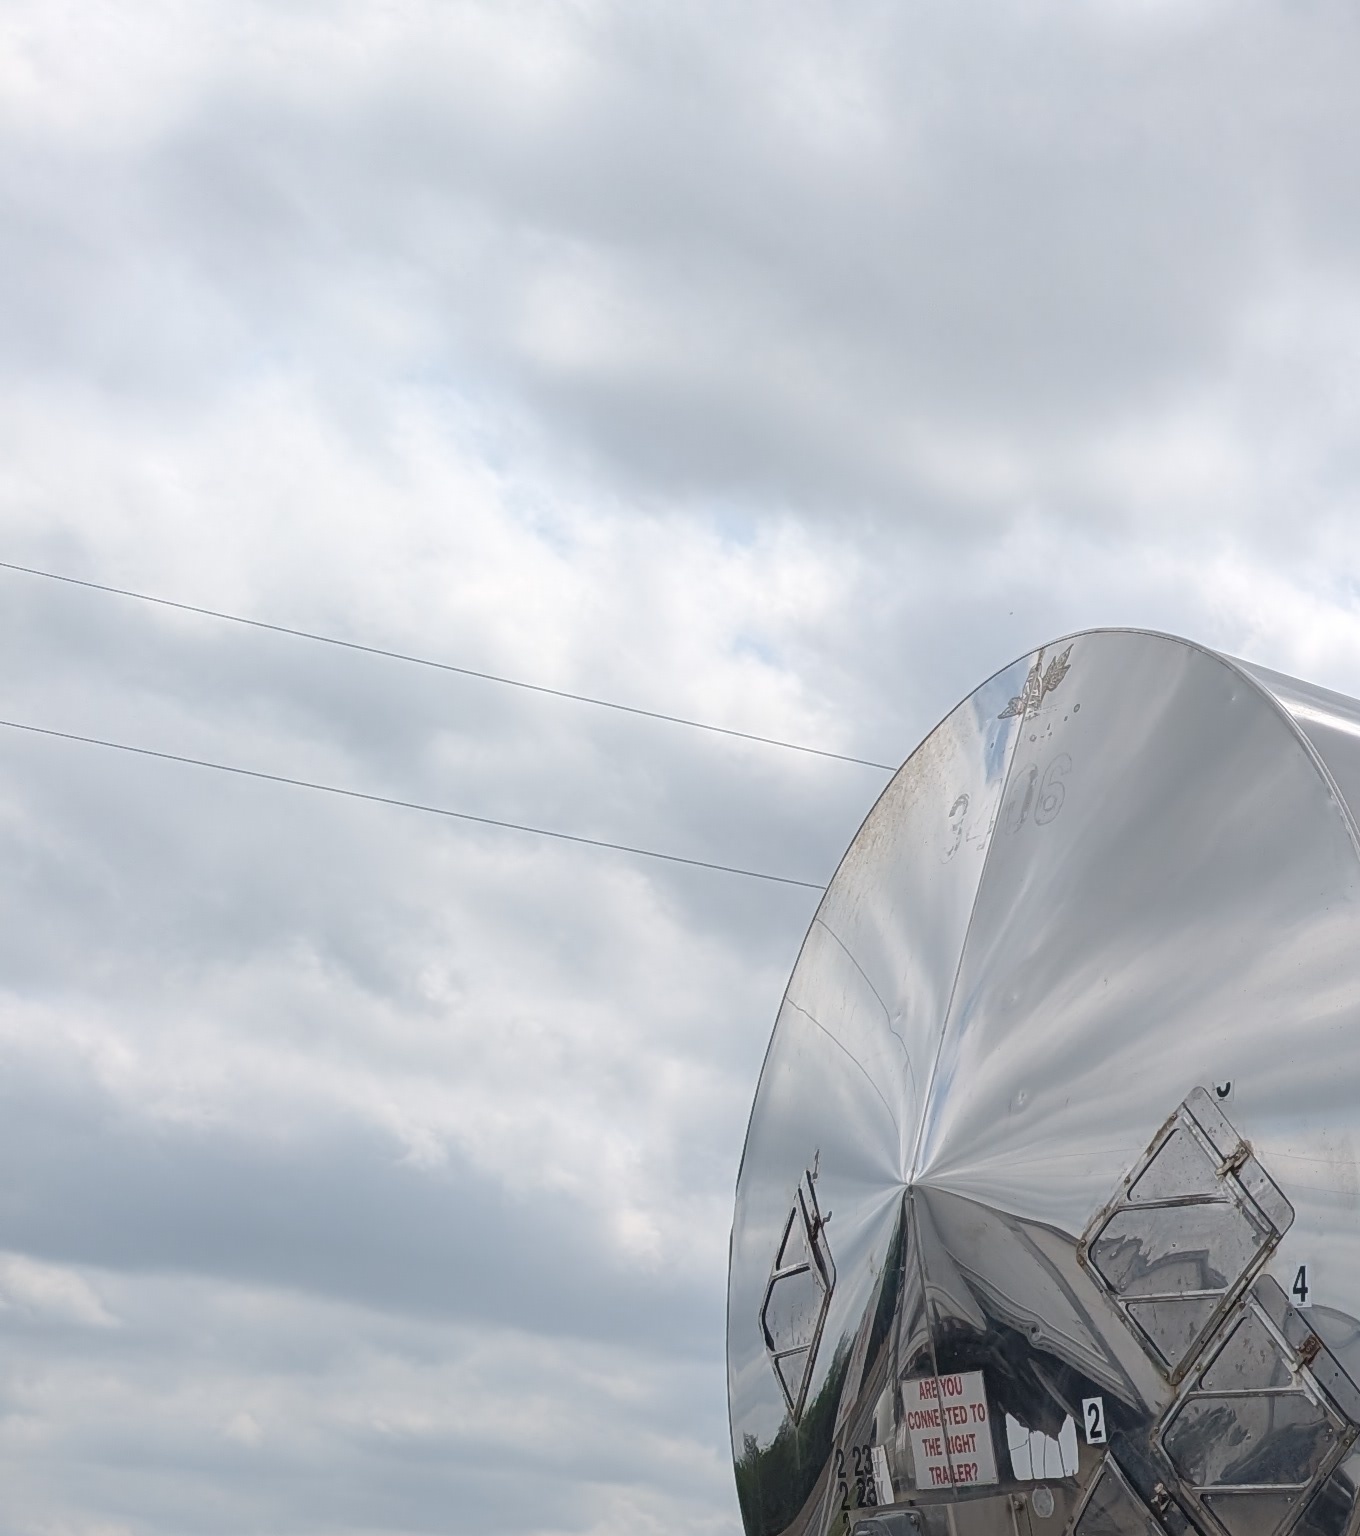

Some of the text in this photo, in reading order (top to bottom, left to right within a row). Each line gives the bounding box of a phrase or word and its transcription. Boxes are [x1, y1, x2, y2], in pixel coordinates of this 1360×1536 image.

[1292, 1265, 1308, 1302] 4
[919, 1376, 963, 1400] ARE YOU
[970, 1403, 986, 1422] TO
[1087, 1403, 1102, 1438] 2
[922, 1437, 942, 1457] THE
